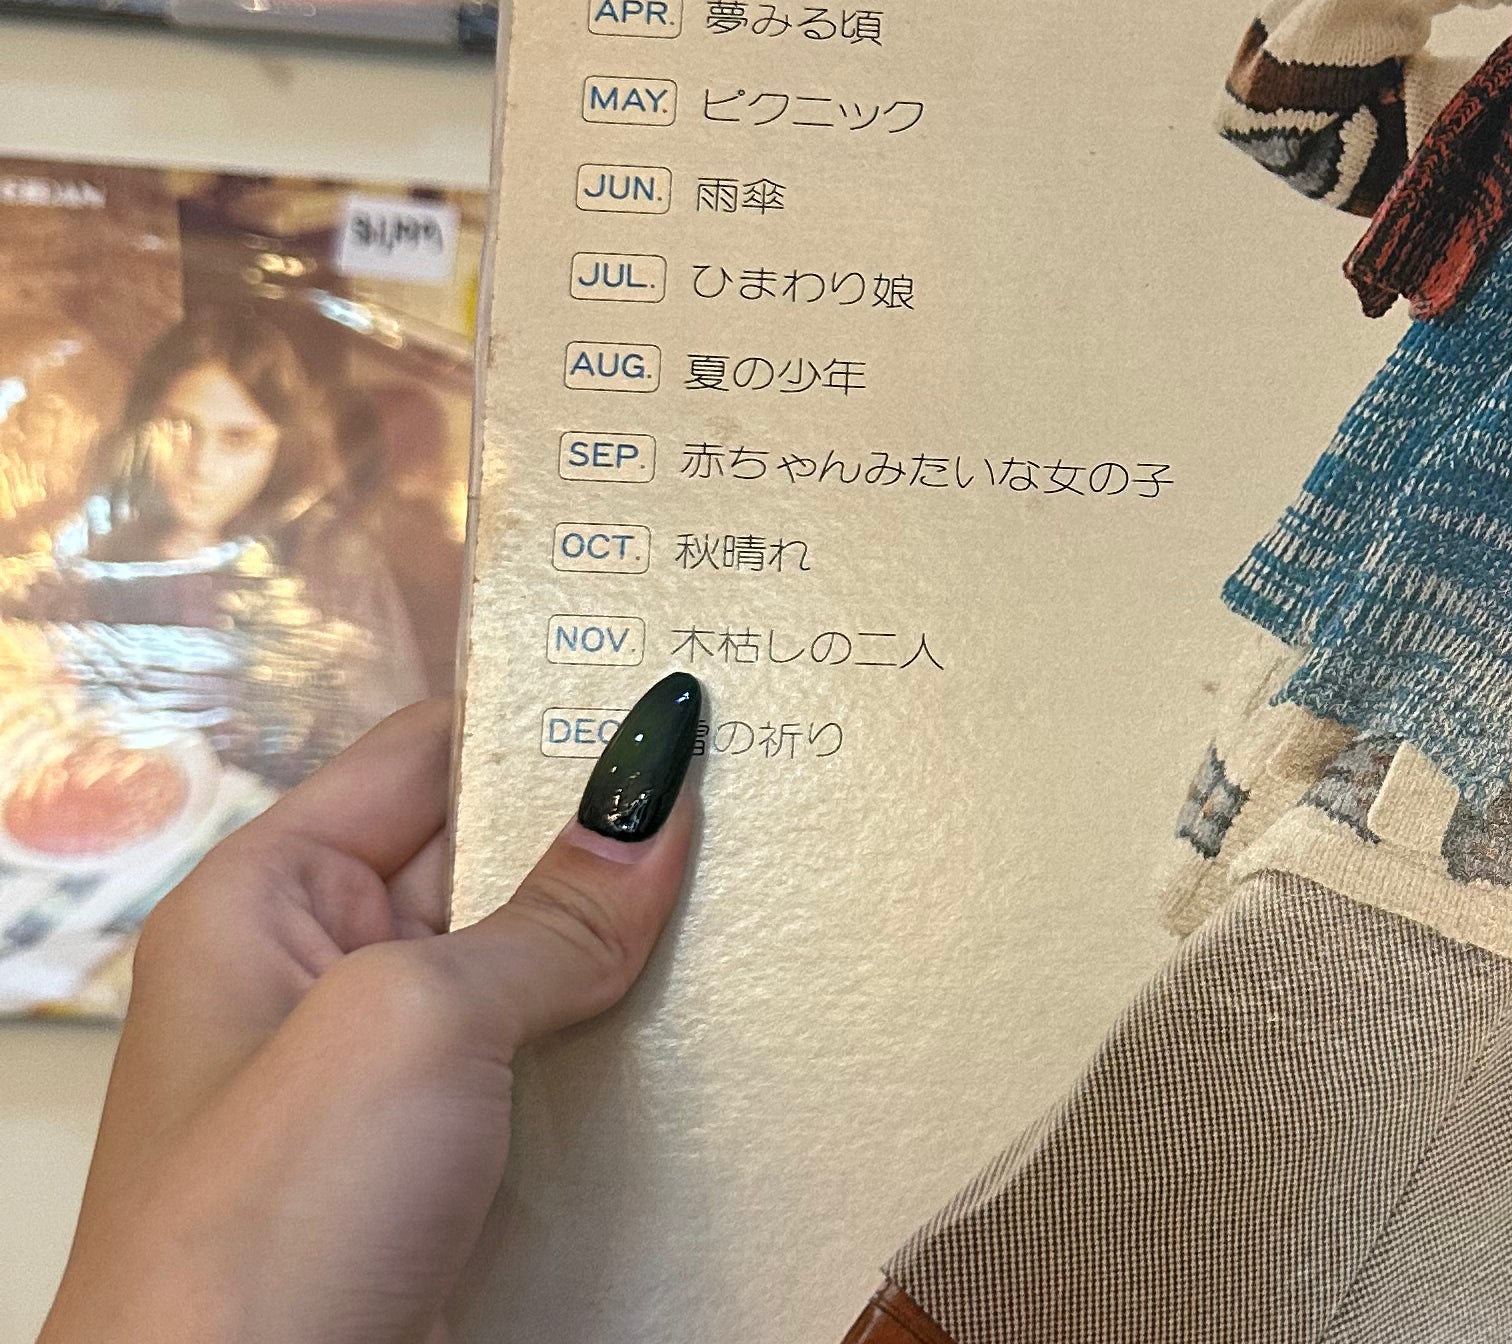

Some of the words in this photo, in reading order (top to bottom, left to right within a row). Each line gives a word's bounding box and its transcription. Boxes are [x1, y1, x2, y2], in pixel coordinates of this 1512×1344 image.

[594, 0, 675, 27] APR.
[706, 0, 885, 46] 夢みる頃
[589, 86, 668, 114] MAY.
[703, 88, 925, 134] ピクニック
[583, 174, 663, 202] JUN.
[696, 176, 787, 216] 雨傘
[578, 262, 656, 290] JUL.
[692, 264, 915, 311] ひまわり娘
[569, 352, 653, 380] AUG.
[685, 353, 868, 396] 夏の少年
[567, 442, 646, 470] SEP.
[680, 442, 1175, 500] 赤ちゃんみたいな女の子
[561, 532, 641, 560] OCT.
[674, 533, 811, 572] 秋晴れ
[555, 626, 636, 654] NOV.
[670, 625, 945, 671] 木枯しの二人
